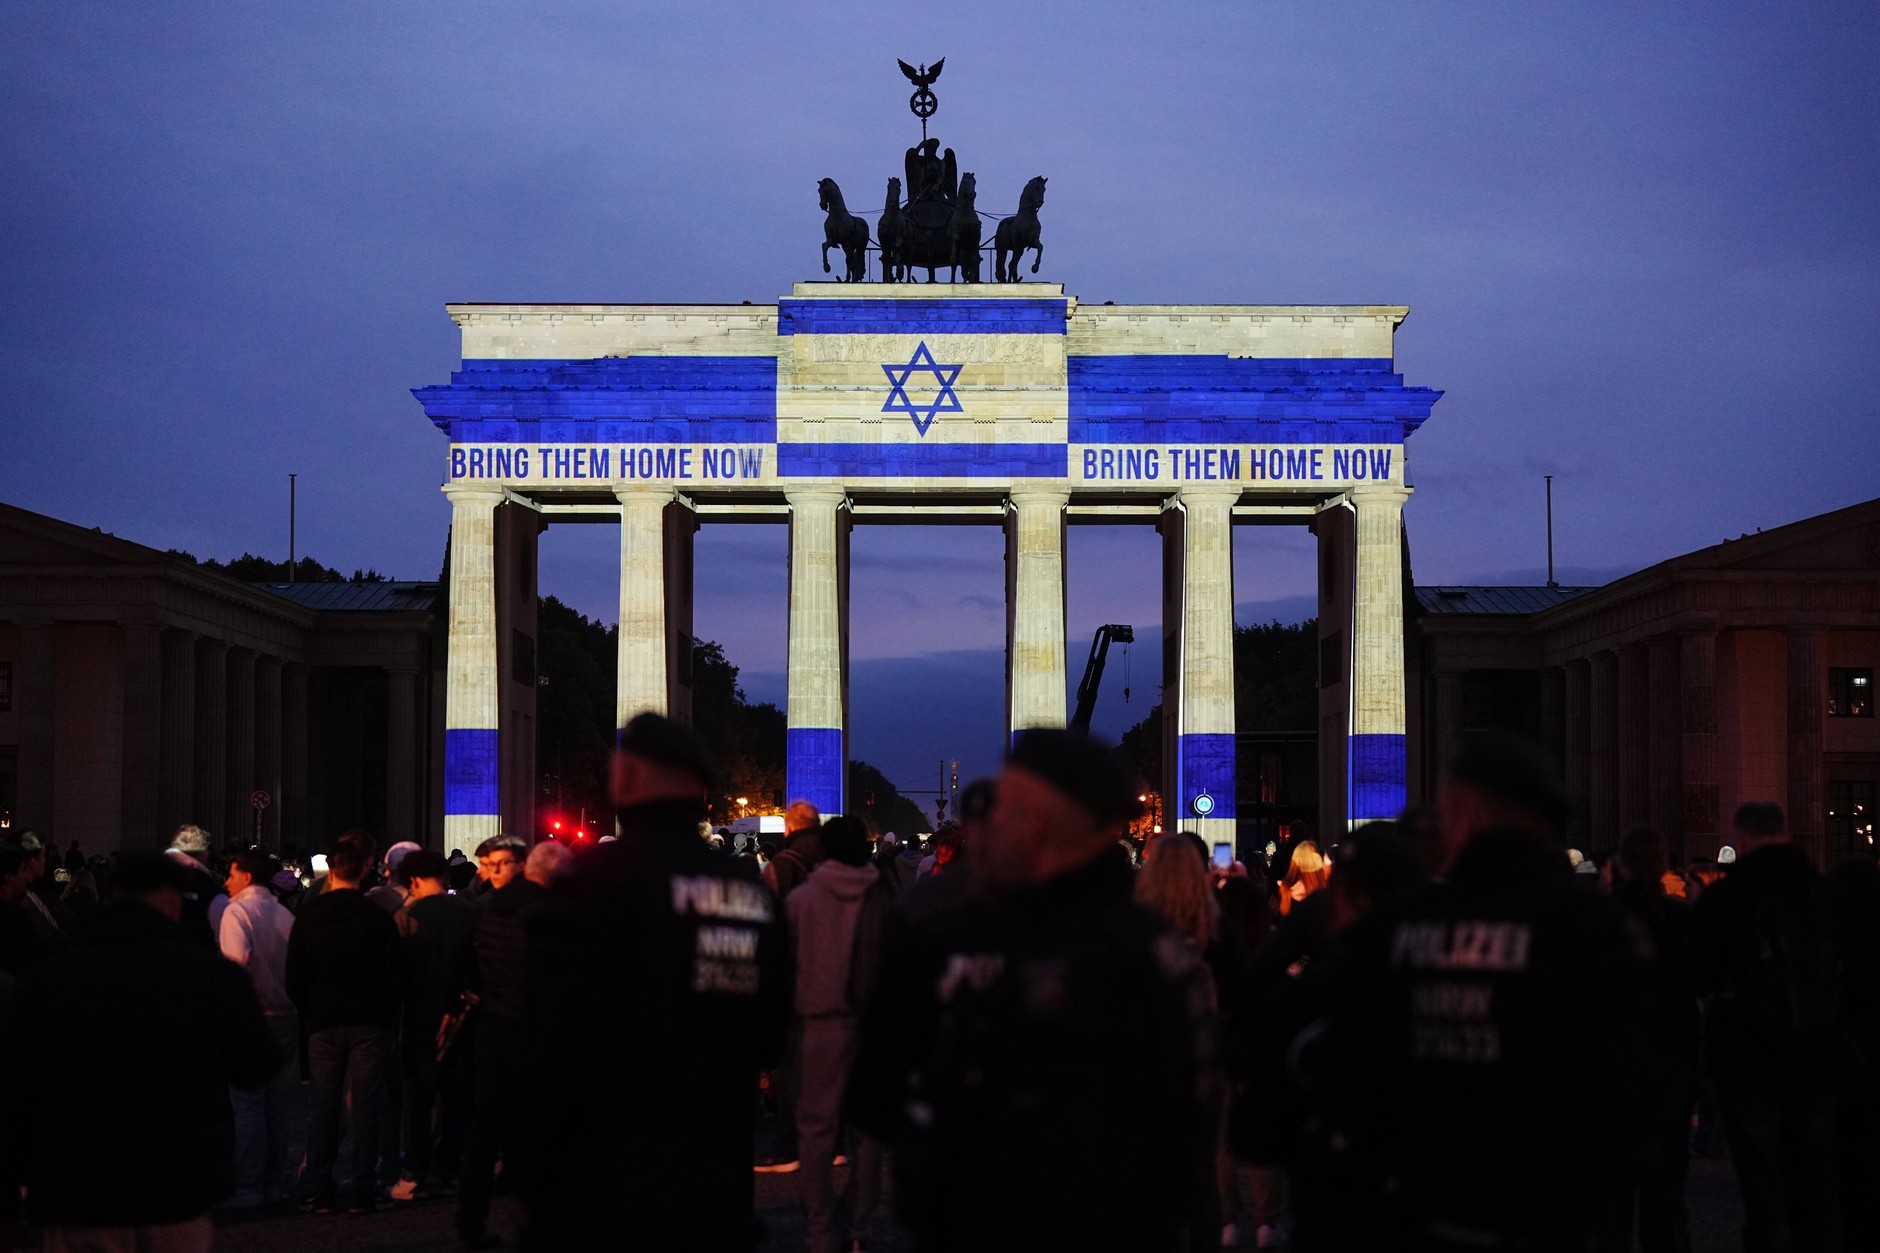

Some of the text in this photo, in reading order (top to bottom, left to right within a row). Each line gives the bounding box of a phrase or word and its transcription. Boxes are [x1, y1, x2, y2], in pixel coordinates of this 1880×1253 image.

[451, 447, 763, 479] BRING THEM HOME NOW
[1083, 448, 1392, 480] BRING THEM HOME NOW
